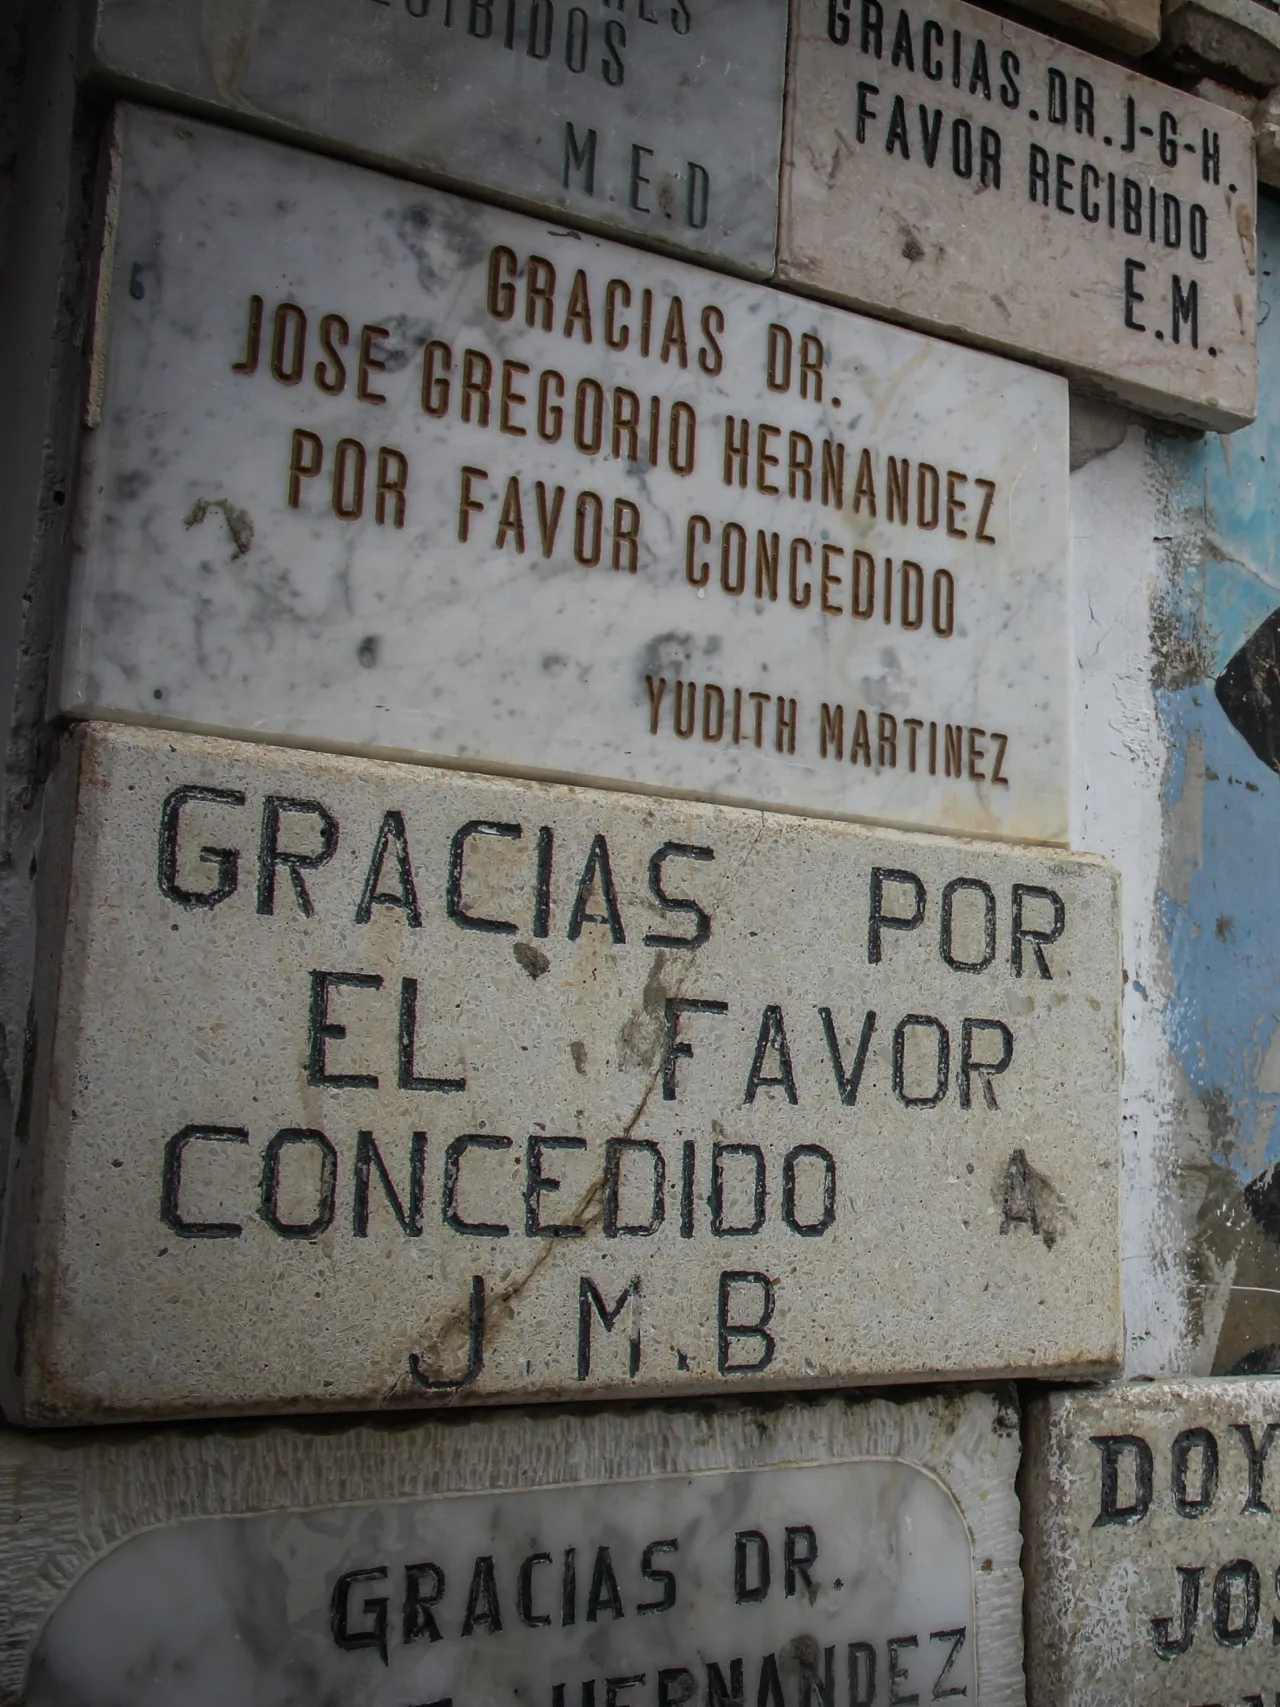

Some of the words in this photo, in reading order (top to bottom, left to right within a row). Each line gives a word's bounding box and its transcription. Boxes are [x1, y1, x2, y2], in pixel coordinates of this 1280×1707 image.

[856, 81, 1001, 190] FAVOR
[1029, 142, 1207, 260] RECIBIDO
[487, 245, 725, 377] GRACIAS
[766, 323, 842, 408] DR.
[231, 294, 391, 405] JOSE
[421, 340, 697, 477] GREGORIO
[723, 414, 998, 545] HERNANDEZ
[288, 428, 409, 529] POR
[458, 465, 640, 575] FAVOR
[685, 514, 955, 638] CONCEDIDO
[645, 675, 797, 756] YUDITH
[819, 702, 1010, 786] MARTINEZ
[157, 783, 715, 949] GRACIAS
[868, 866, 1066, 980] POR
[307, 968, 467, 1092] EL
[662, 997, 1014, 1111] FAVOR
[160, 1124, 837, 1238] CONCEDIDO
[330, 1536, 679, 1667] GRACIAS
